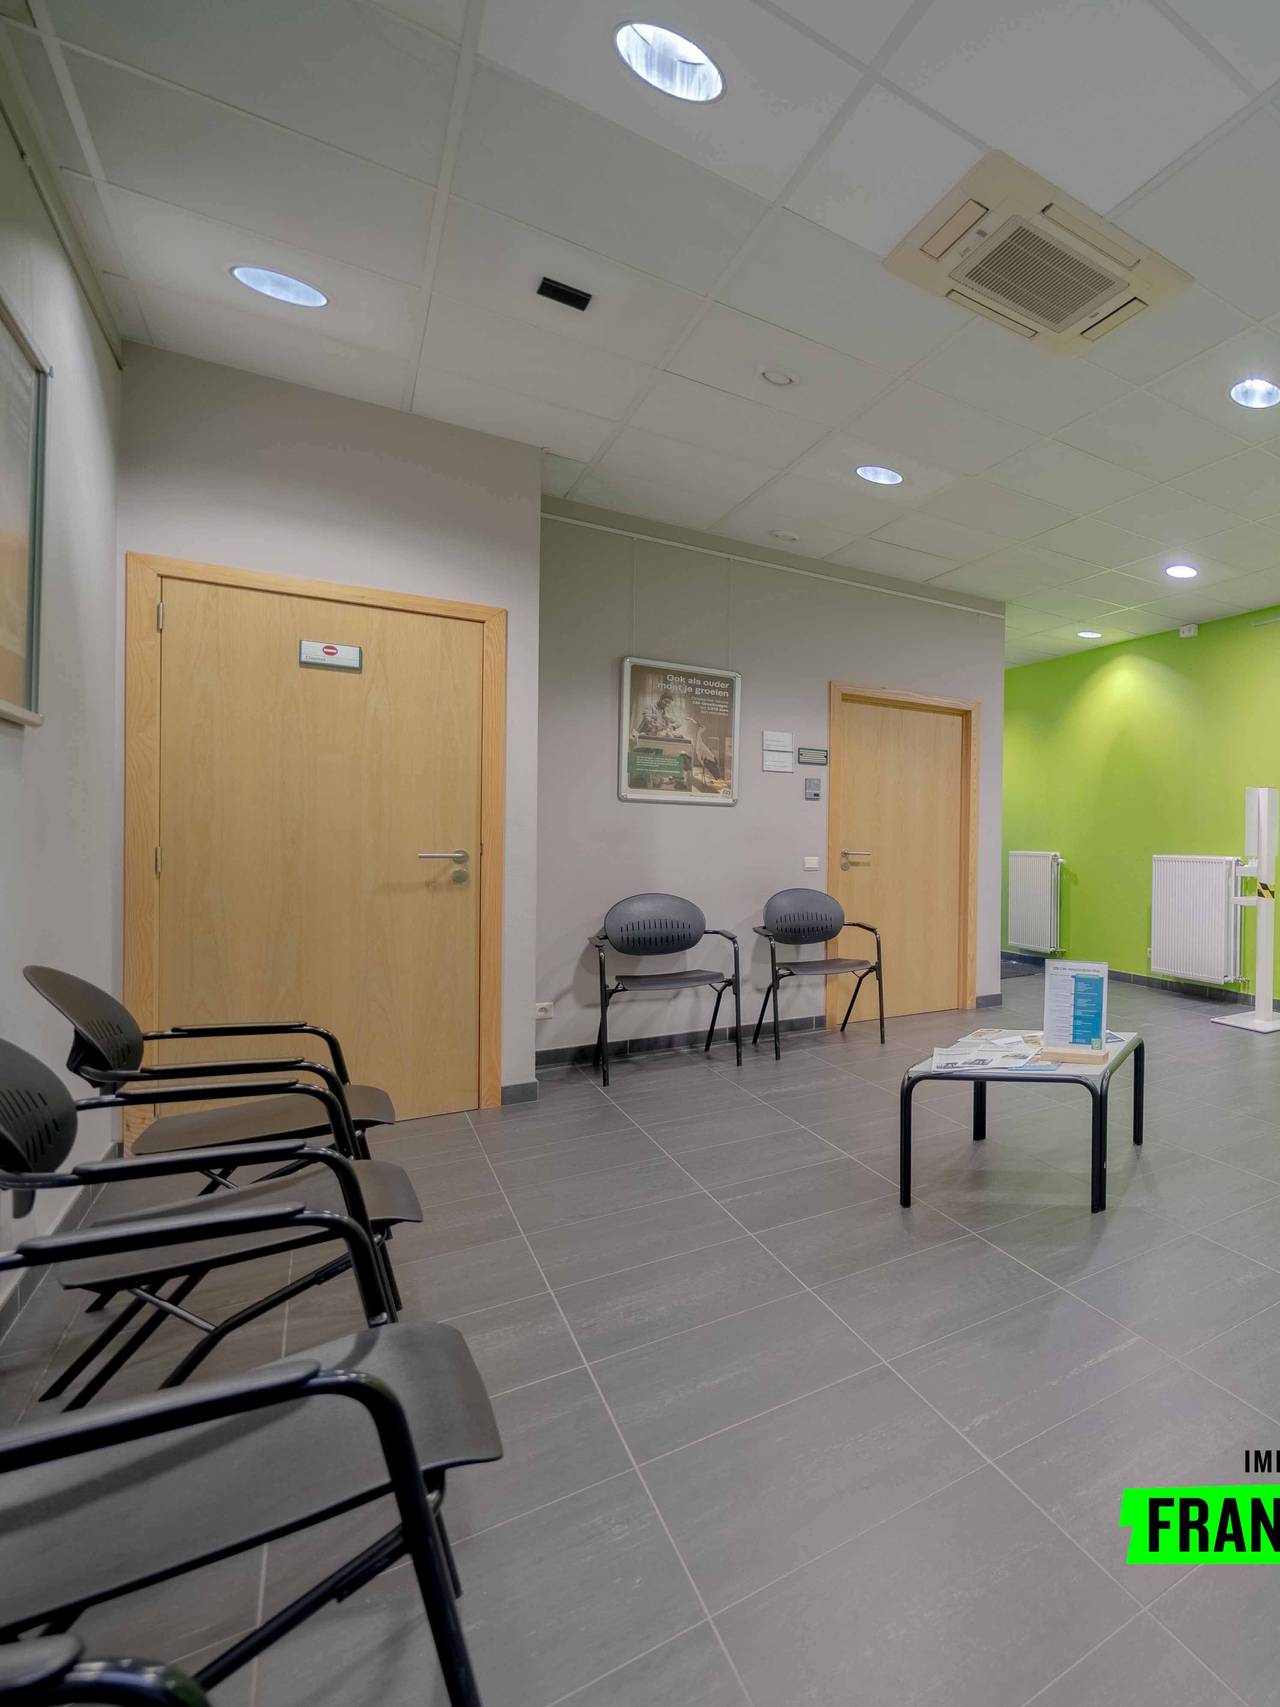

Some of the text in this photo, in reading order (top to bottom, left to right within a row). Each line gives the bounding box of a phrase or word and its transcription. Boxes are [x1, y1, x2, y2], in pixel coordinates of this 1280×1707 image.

[667, 674, 686, 683] Ook
[703, 680, 730, 689] ouder
[695, 687, 729, 697] groeien
